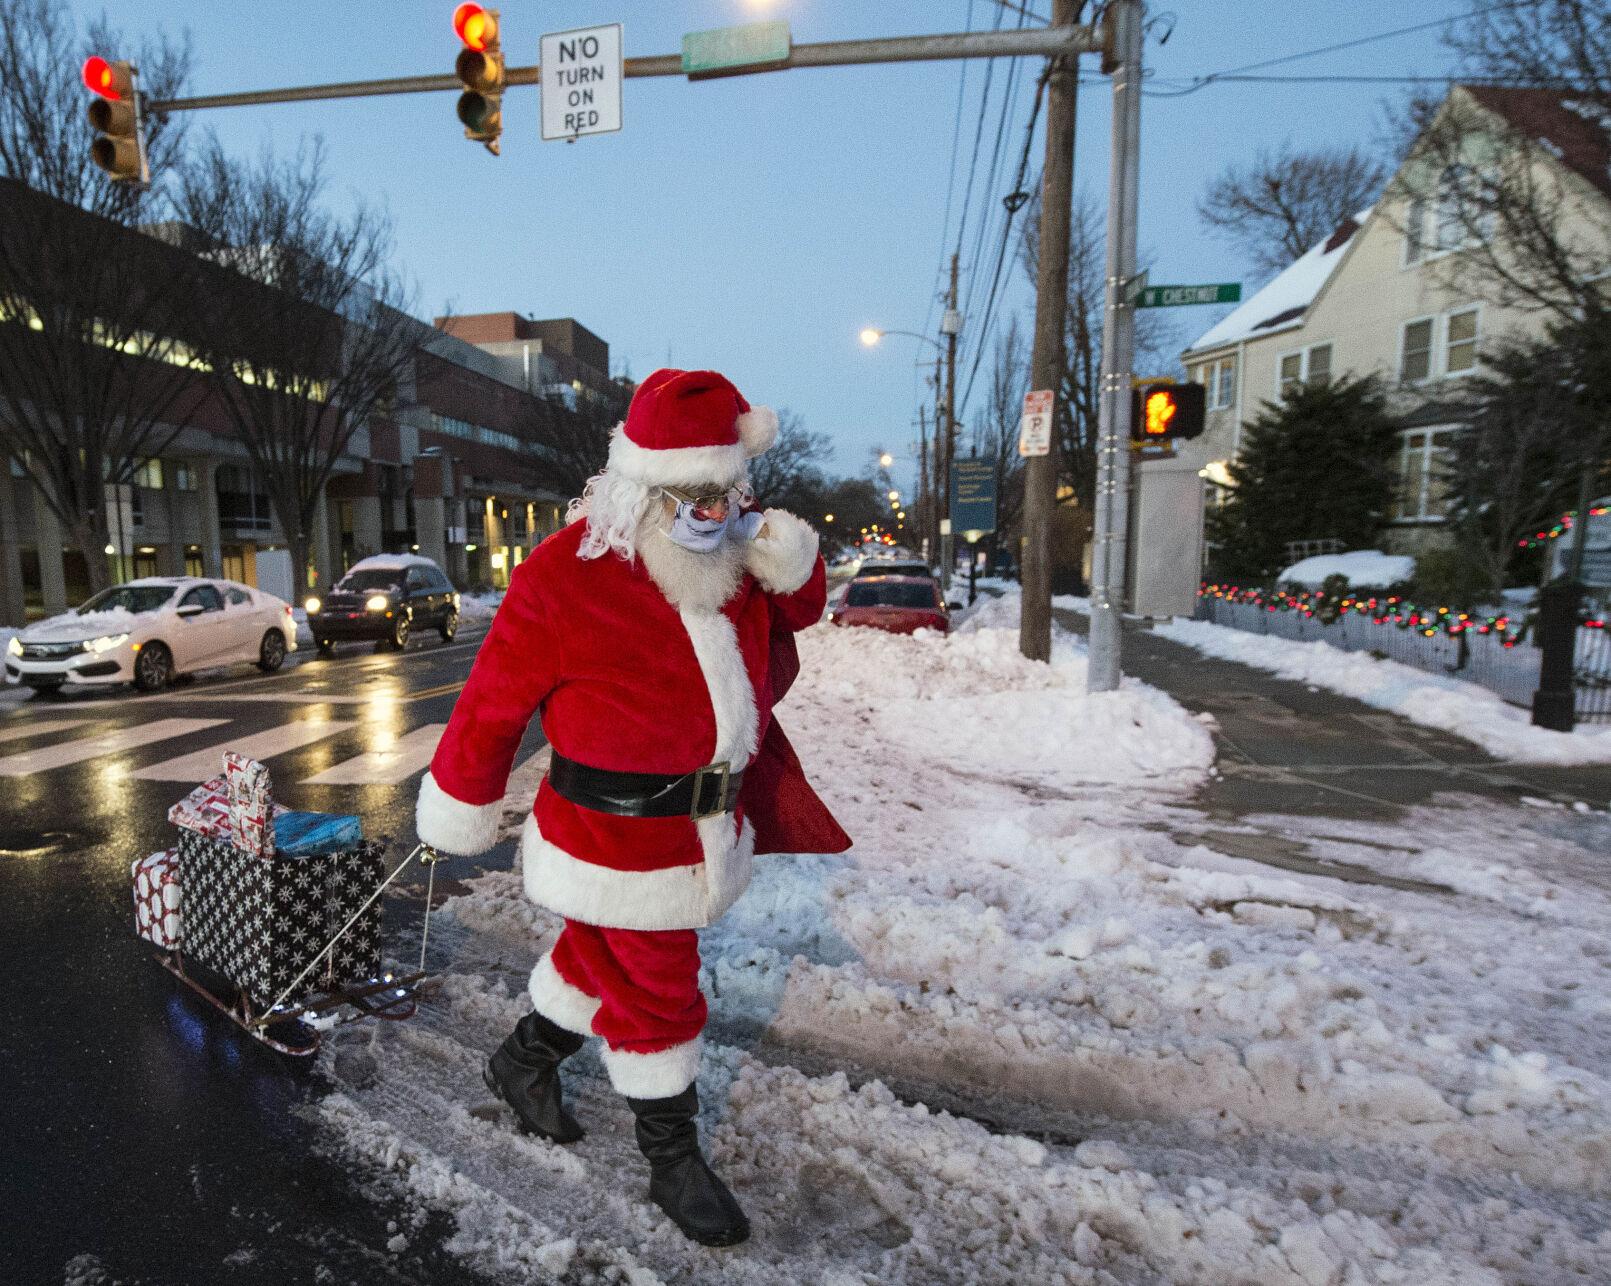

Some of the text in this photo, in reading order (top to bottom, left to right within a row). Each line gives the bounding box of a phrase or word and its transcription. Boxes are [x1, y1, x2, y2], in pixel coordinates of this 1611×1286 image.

[559, 36, 599, 63] NO
[556, 65, 604, 87] TURN
[568, 87, 594, 107] ON
[564, 110, 599, 130] RED
[1162, 286, 1218, 305] CHESTNUT
